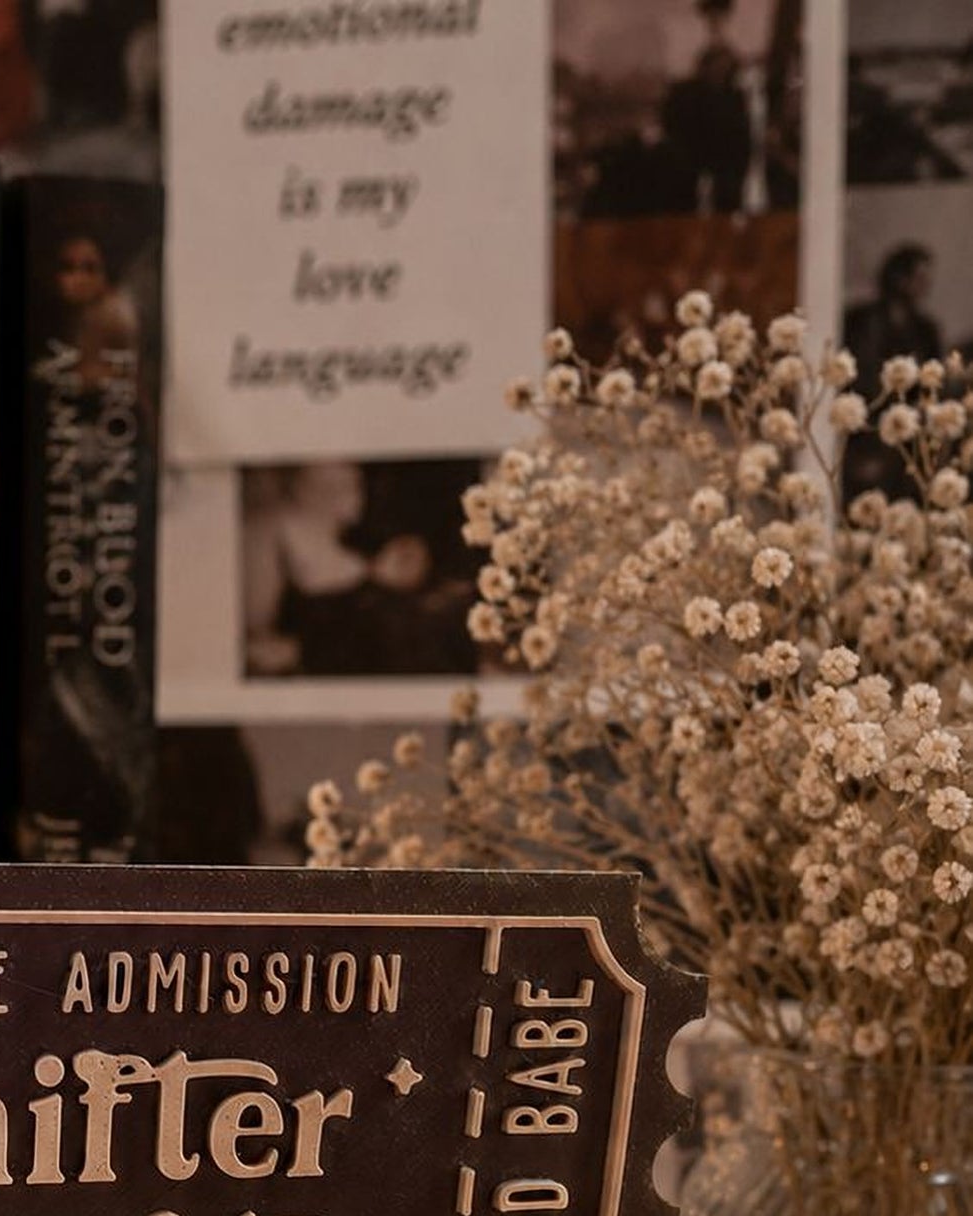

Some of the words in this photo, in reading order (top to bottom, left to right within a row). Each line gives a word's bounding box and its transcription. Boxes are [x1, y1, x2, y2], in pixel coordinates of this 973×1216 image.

[218, 0, 479, 53] emotional
[243, 79, 451, 141] damage
[280, 169, 320, 217] is
[338, 176, 417, 229] my
[294, 250, 401, 304] love
[230, 336, 470, 402] language
[62, 951, 403, 1014] ADMISSION
[501, 977, 596, 1136] BABE
